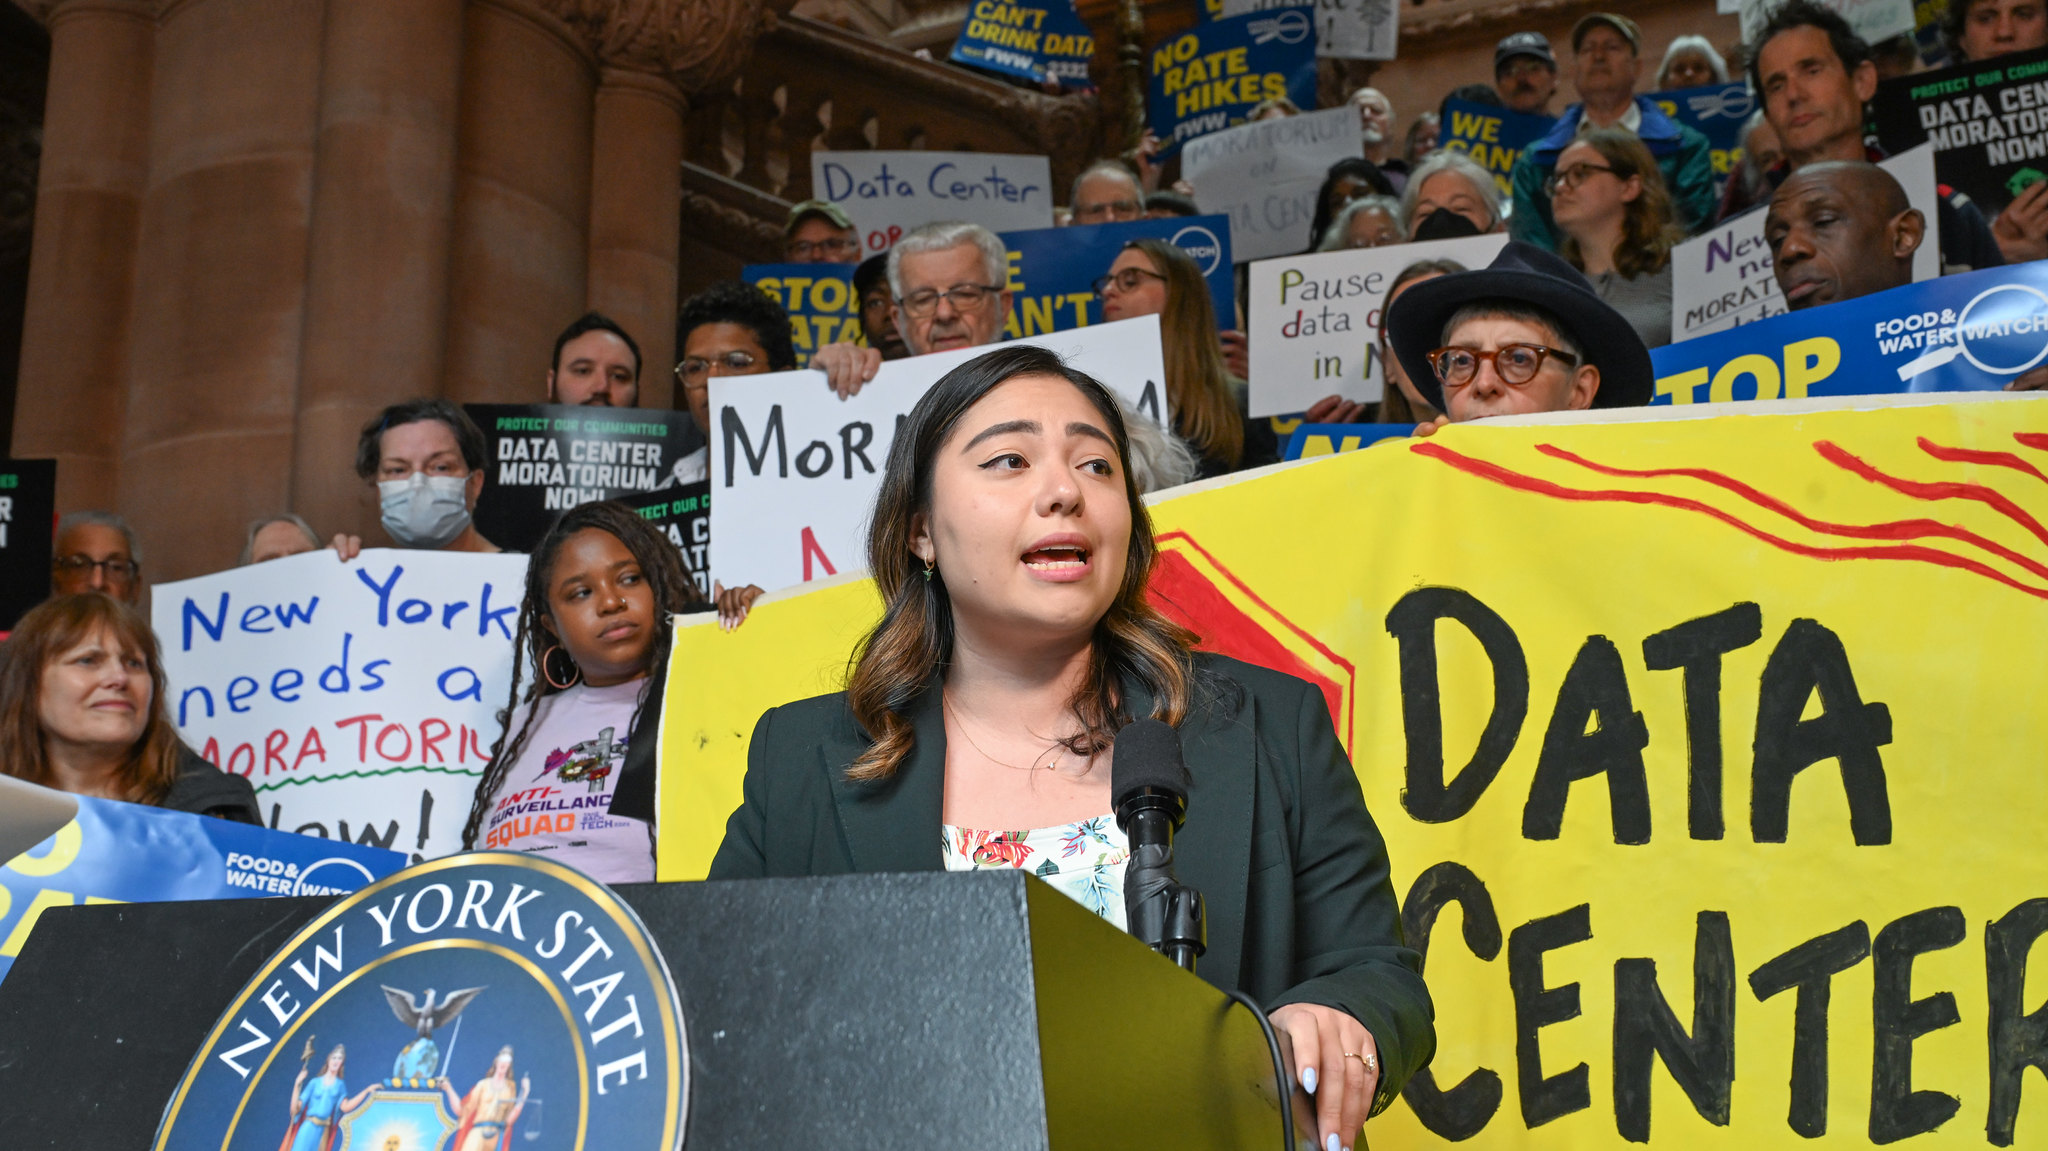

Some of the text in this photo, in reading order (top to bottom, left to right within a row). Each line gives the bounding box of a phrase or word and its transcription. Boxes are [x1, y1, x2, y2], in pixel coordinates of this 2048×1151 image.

[974, 1, 1047, 29] CAN'T
[967, 20, 1095, 57] DRINK DATA
[1153, 34, 1199, 75] NO
[984, 47, 1033, 70] FWW
[1164, 47, 1249, 96] RATE
[1176, 73, 1287, 117] HIKES
[1910, 77, 1969, 99] PROTECT
[1974, 70, 2003, 87] OUR
[1918, 80, 2048, 129] DATA CEN
[1174, 112, 1227, 142] FWW
[1192, 114, 1350, 164] MORATORIUM
[1452, 110, 1502, 143] WE
[1928, 106, 2048, 152] MORATOR
[1986, 130, 2048, 167] NOW
[823, 162, 1039, 203] Data Center
[1264, 190, 1318, 232] CEN
[1006, 251, 1026, 292] E
[1280, 269, 1383, 305] Pause
[1003, 292, 1094, 339] AN'T
[1684, 275, 1775, 330] MORAT
[789, 315, 868, 350] ATA
[1282, 305, 1352, 338] data
[1879, 314, 2048, 356] WATER WATCH
[1313, 351, 1342, 380] in
[1652, 336, 1841, 406] TOP
[496, 417, 668, 437] PROTECT OUR COMMUNITIES
[497, 437, 662, 467] DATA CENTER
[498, 461, 657, 491] MORATORIUM
[633, 503, 669, 520] TECT
[672, 496, 699, 515] OUR
[182, 564, 518, 652] New York
[178, 632, 482, 727] needs a
[1385, 584, 1893, 847] DATA
[201, 714, 494, 779] ORATORIU
[489, 794, 612, 829] SURVEILLANC
[496, 786, 561, 813] ANTI-
[485, 813, 575, 850] SQUAD
[580, 820, 613, 831] TECH
[226, 870, 293, 895] WATER
[219, 878, 648, 1095] NEW YORK STATE
[1399, 860, 2048, 1146] CENTER
